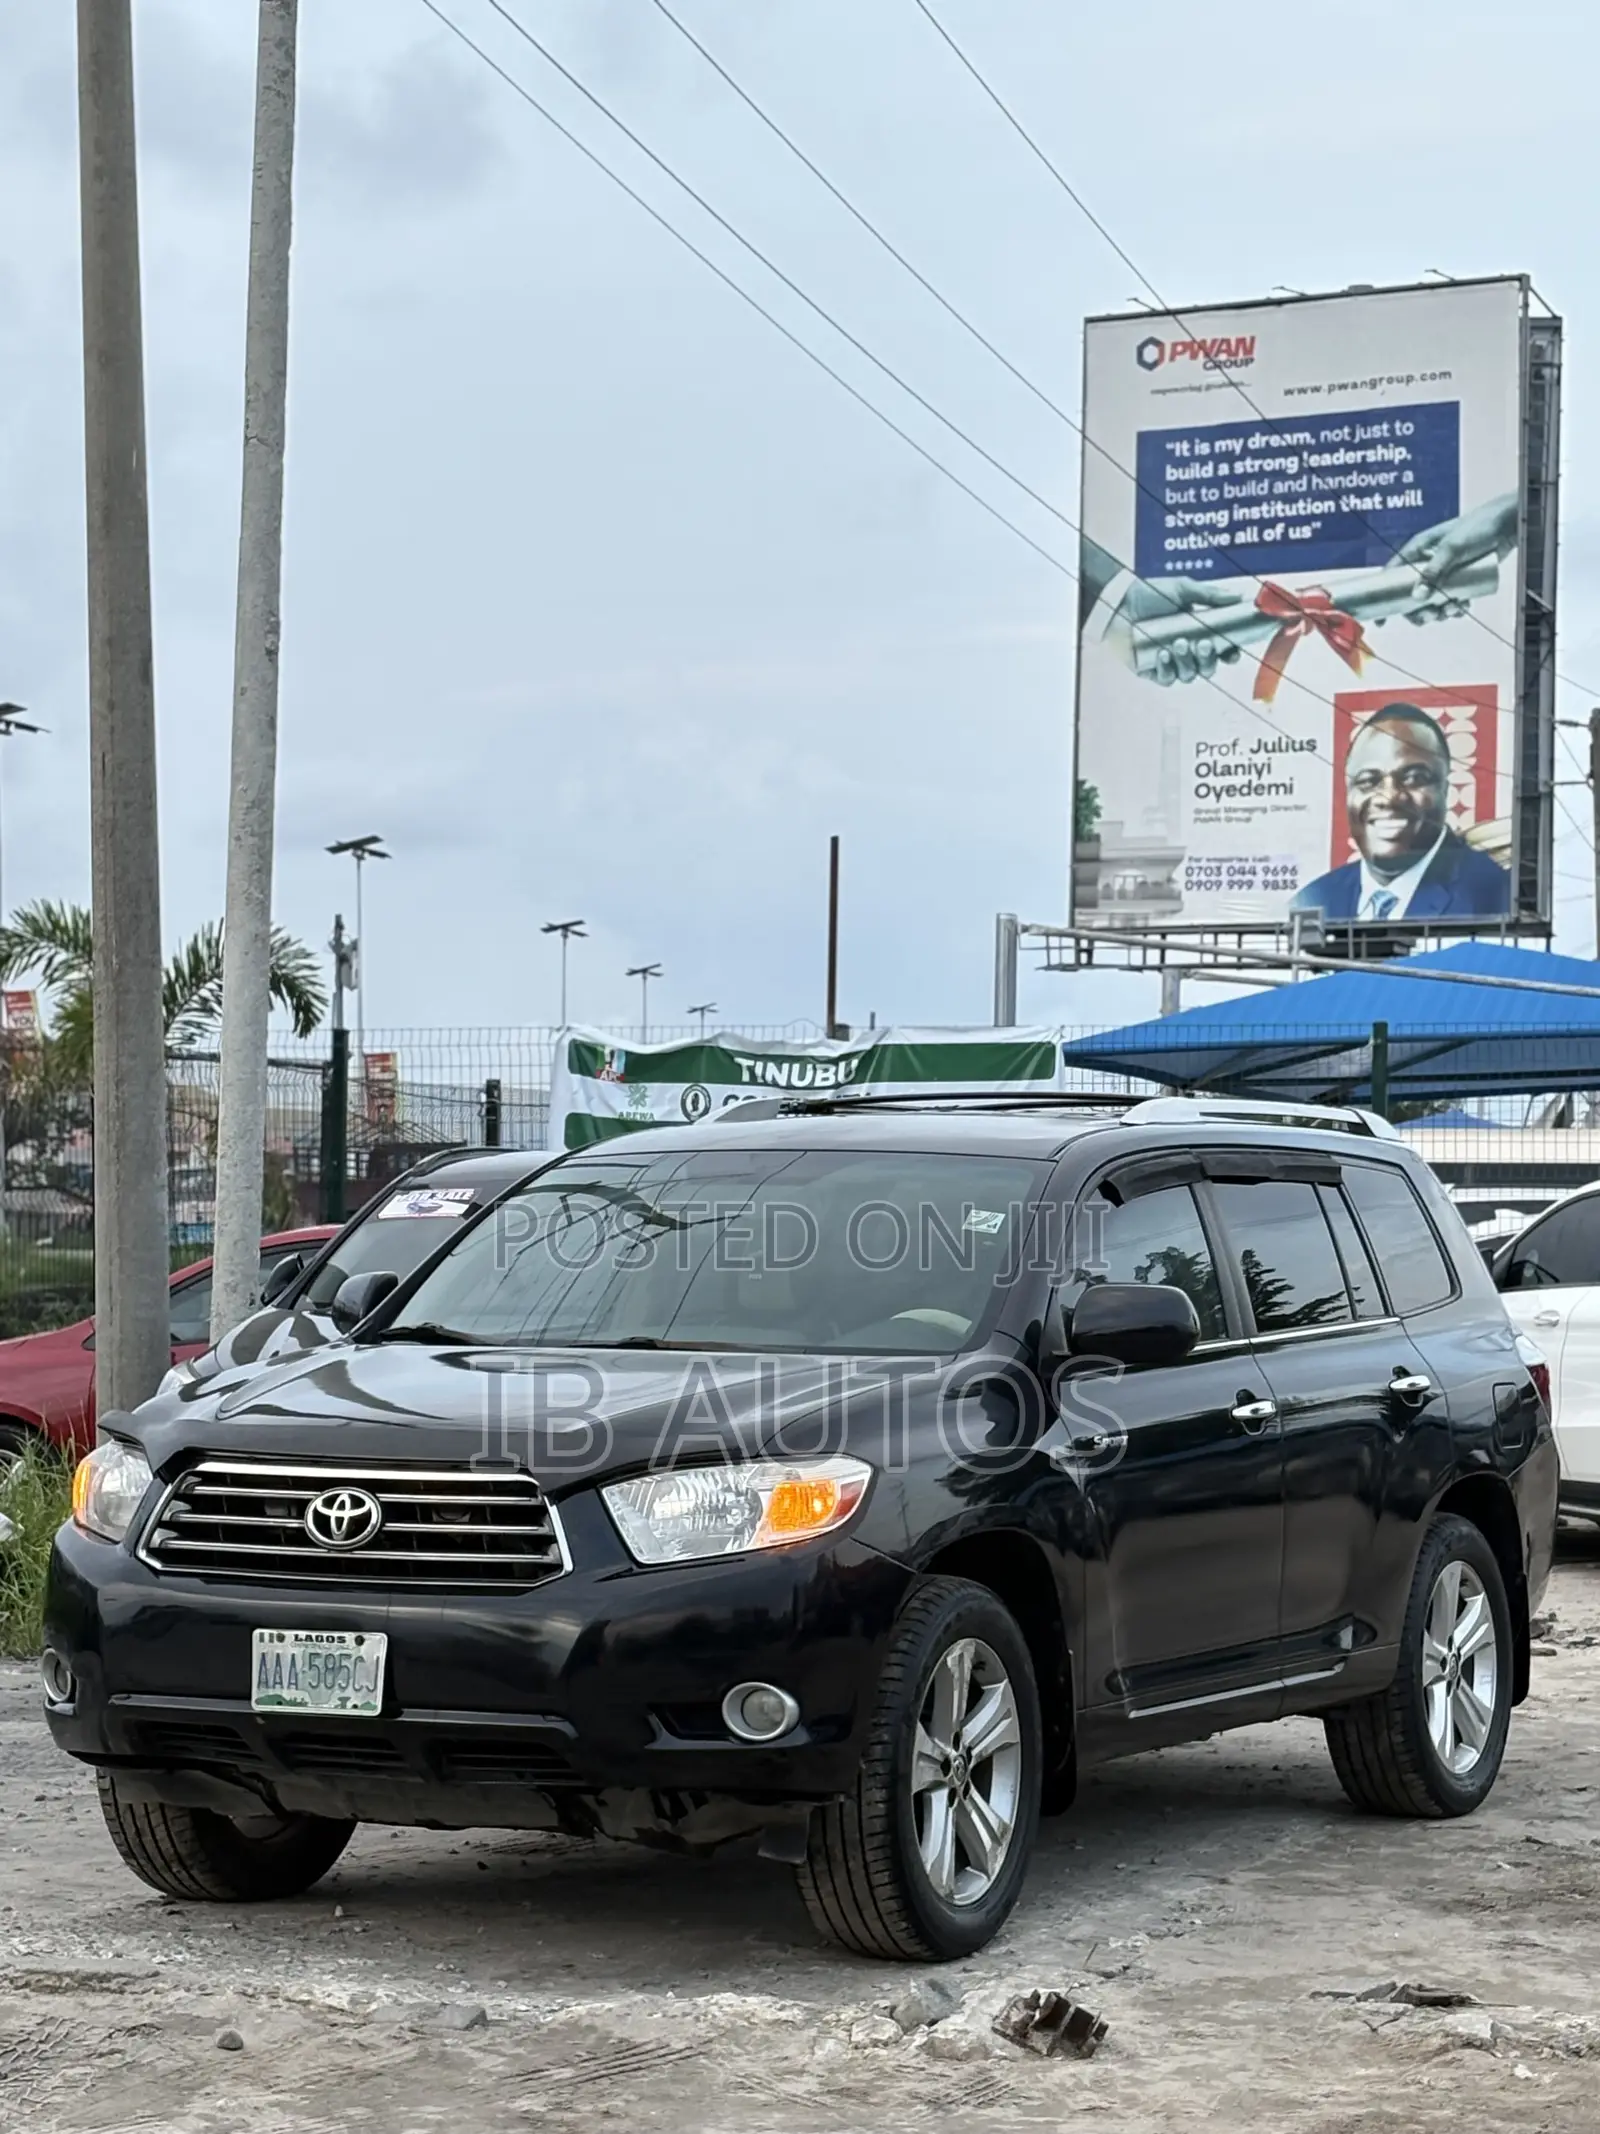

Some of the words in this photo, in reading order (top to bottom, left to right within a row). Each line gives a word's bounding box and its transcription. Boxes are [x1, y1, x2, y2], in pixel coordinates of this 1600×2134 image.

[1169, 336, 1256, 362] PWAN
[1203, 357, 1255, 371] GROUP
[1284, 371, 1452, 396] www.pwangroup.com
[1194, 438, 1210, 455] is
[1214, 437, 1244, 456] my
[1320, 425, 1351, 443] not
[1353, 421, 1391, 444] just
[1394, 420, 1415, 436] to
[1165, 460, 1213, 481] build
[1218, 462, 1230, 476] a
[1234, 456, 1299, 474] strong
[1165, 488, 1196, 505] but
[1200, 486, 1220, 502] to
[1223, 478, 1269, 499] build
[1272, 474, 1307, 494] and
[1312, 470, 1399, 491] handover
[1402, 470, 1414, 483] a
[1165, 508, 1229, 528] strong
[1232, 497, 1336, 521] institution
[1340, 492, 1383, 512] that
[1387, 488, 1423, 508] will
[1164, 531, 1231, 551] outlive
[1234, 526, 1260, 544] all
[1263, 522, 1286, 541] of
[1196, 737, 1243, 758] Prof.
[1250, 736, 1317, 754] Julius
[1195, 757, 1272, 781] Olaniyi
[1194, 777, 1294, 803] Oyedemi
[1185, 866, 1222, 877] 0703
[1226, 866, 1257, 877] 044
[1262, 865, 1298, 877] 9696
[1185, 879, 1222, 891] 0909
[1227, 879, 1254, 890] 999
[1262, 879, 1298, 890] 9835
[733, 1057, 859, 1088] TINUBU
